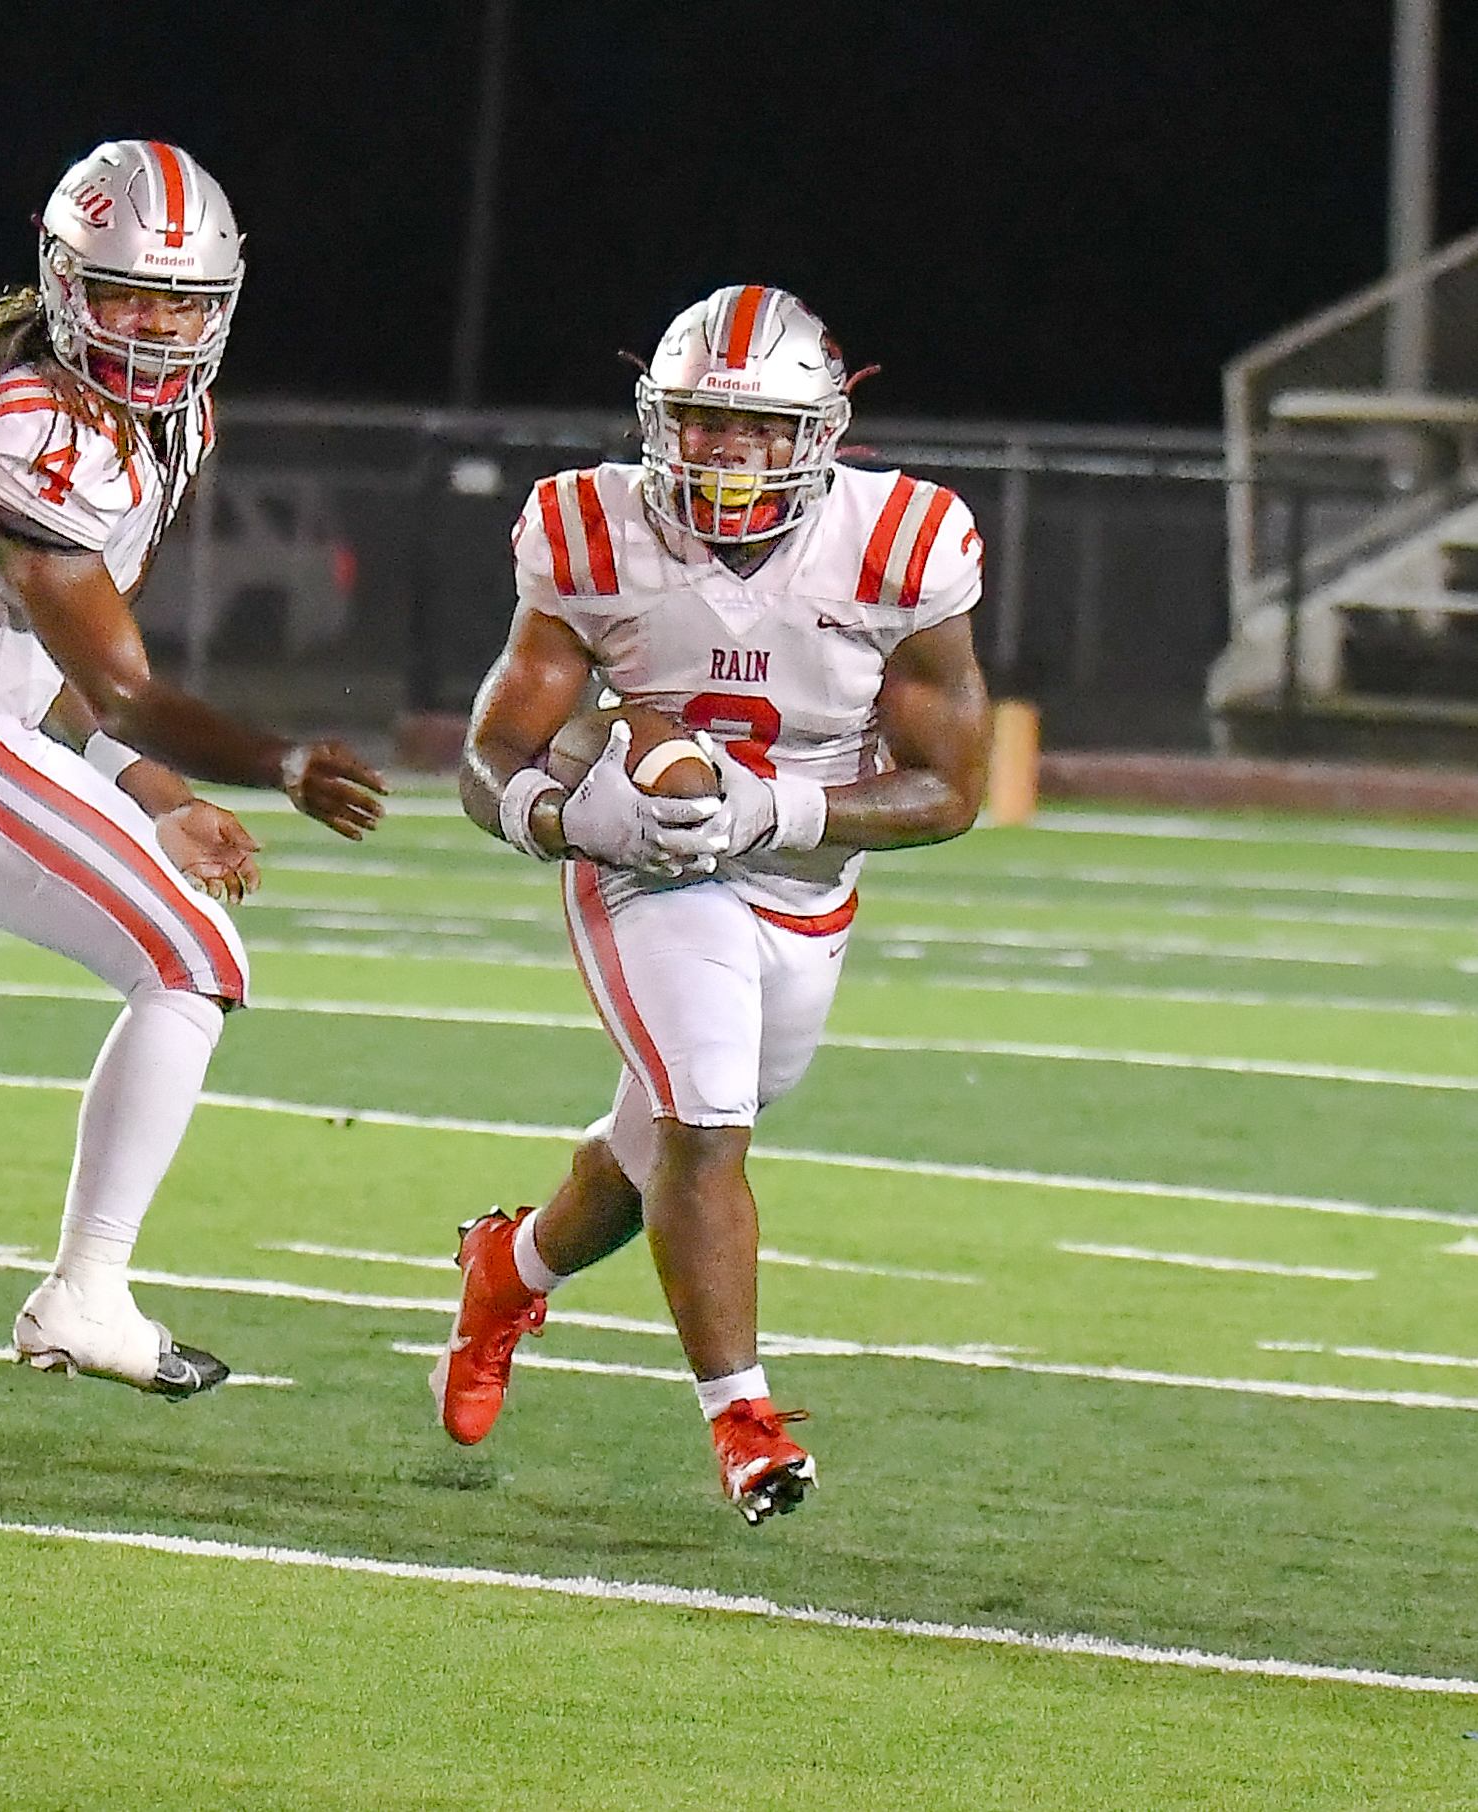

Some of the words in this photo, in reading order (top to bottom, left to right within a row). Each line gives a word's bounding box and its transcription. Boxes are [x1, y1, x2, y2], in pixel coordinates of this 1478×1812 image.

[144, 253, 195, 267] Riddell
[706, 376, 761, 392] Riddell
[33, 444, 82, 506] 4
[709, 648, 771, 682] RAIN
